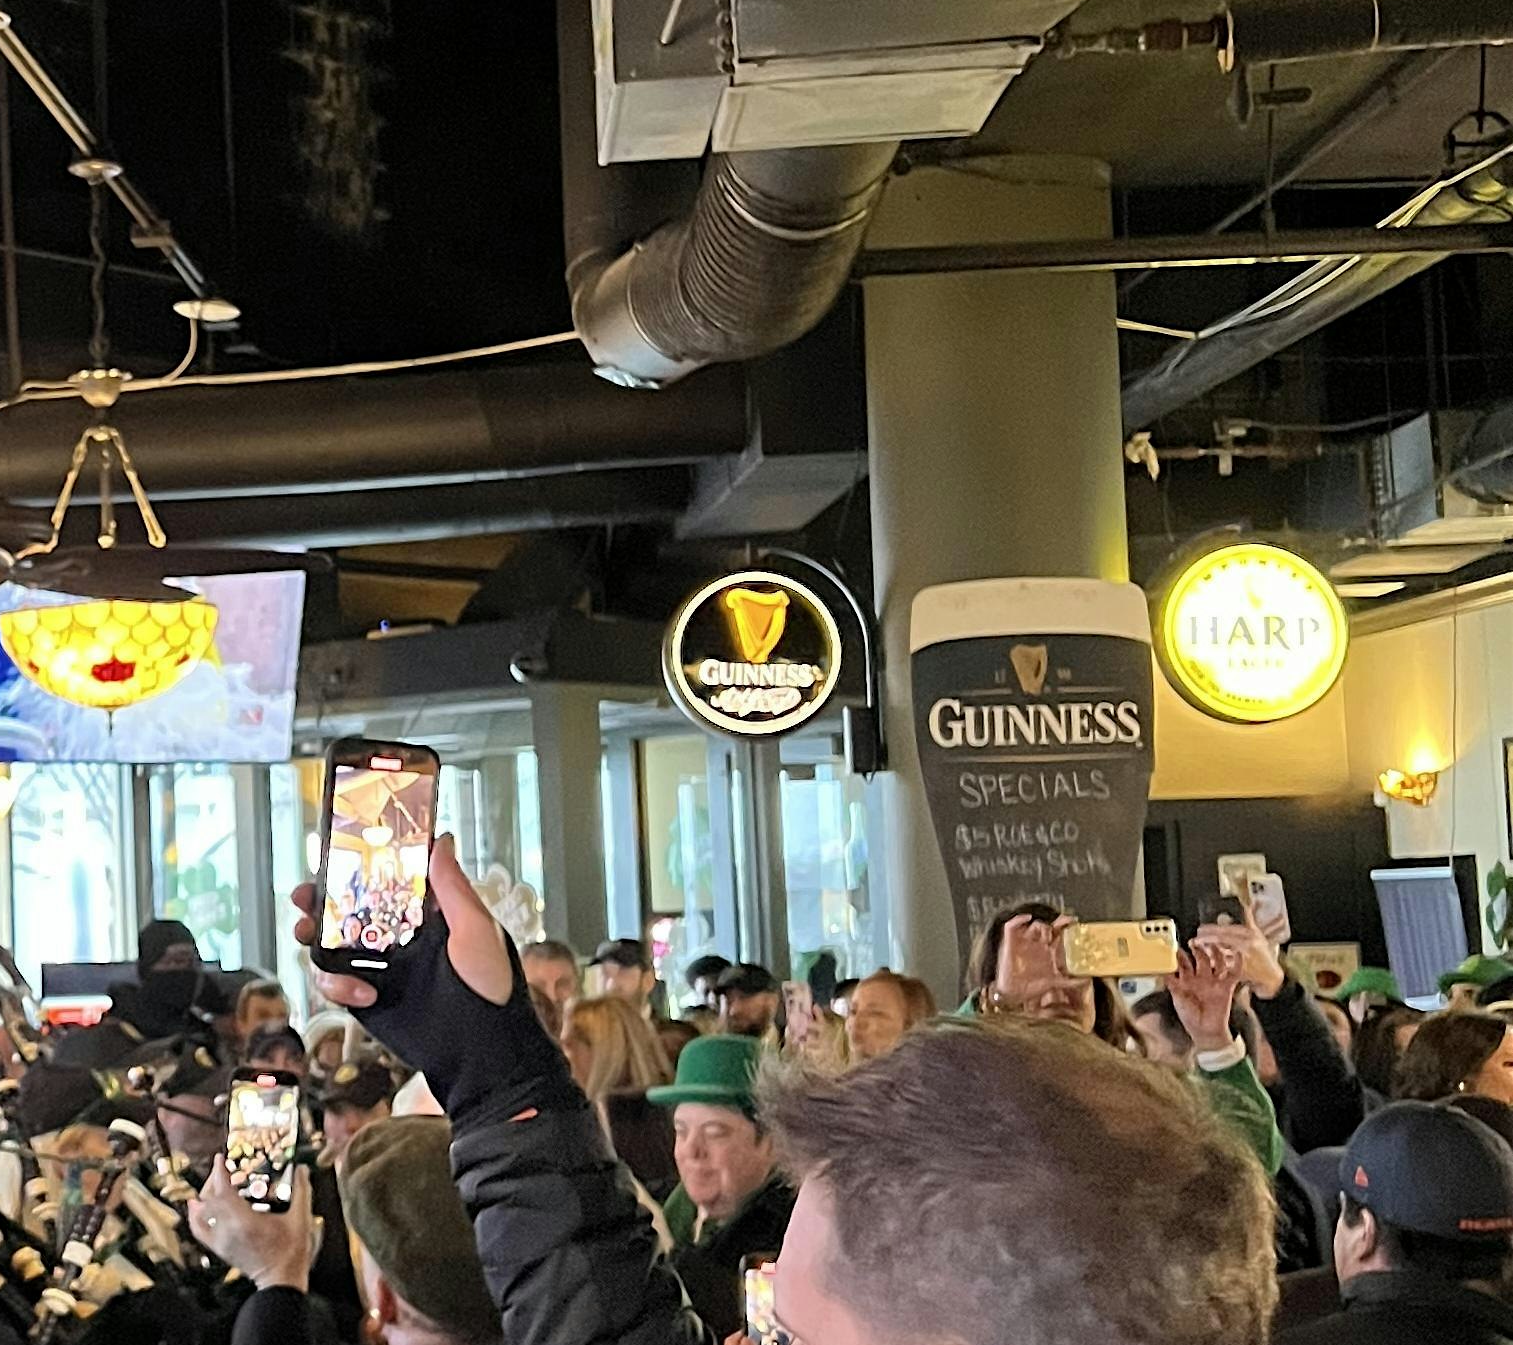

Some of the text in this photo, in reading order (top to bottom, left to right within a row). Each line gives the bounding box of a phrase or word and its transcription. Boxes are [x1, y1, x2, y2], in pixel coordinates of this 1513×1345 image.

[1190, 616, 1321, 650] HARP
[698, 658, 816, 688] GUINNESS
[928, 698, 1141, 748] GUINNESS
[959, 769, 1111, 808] SPECIALS
